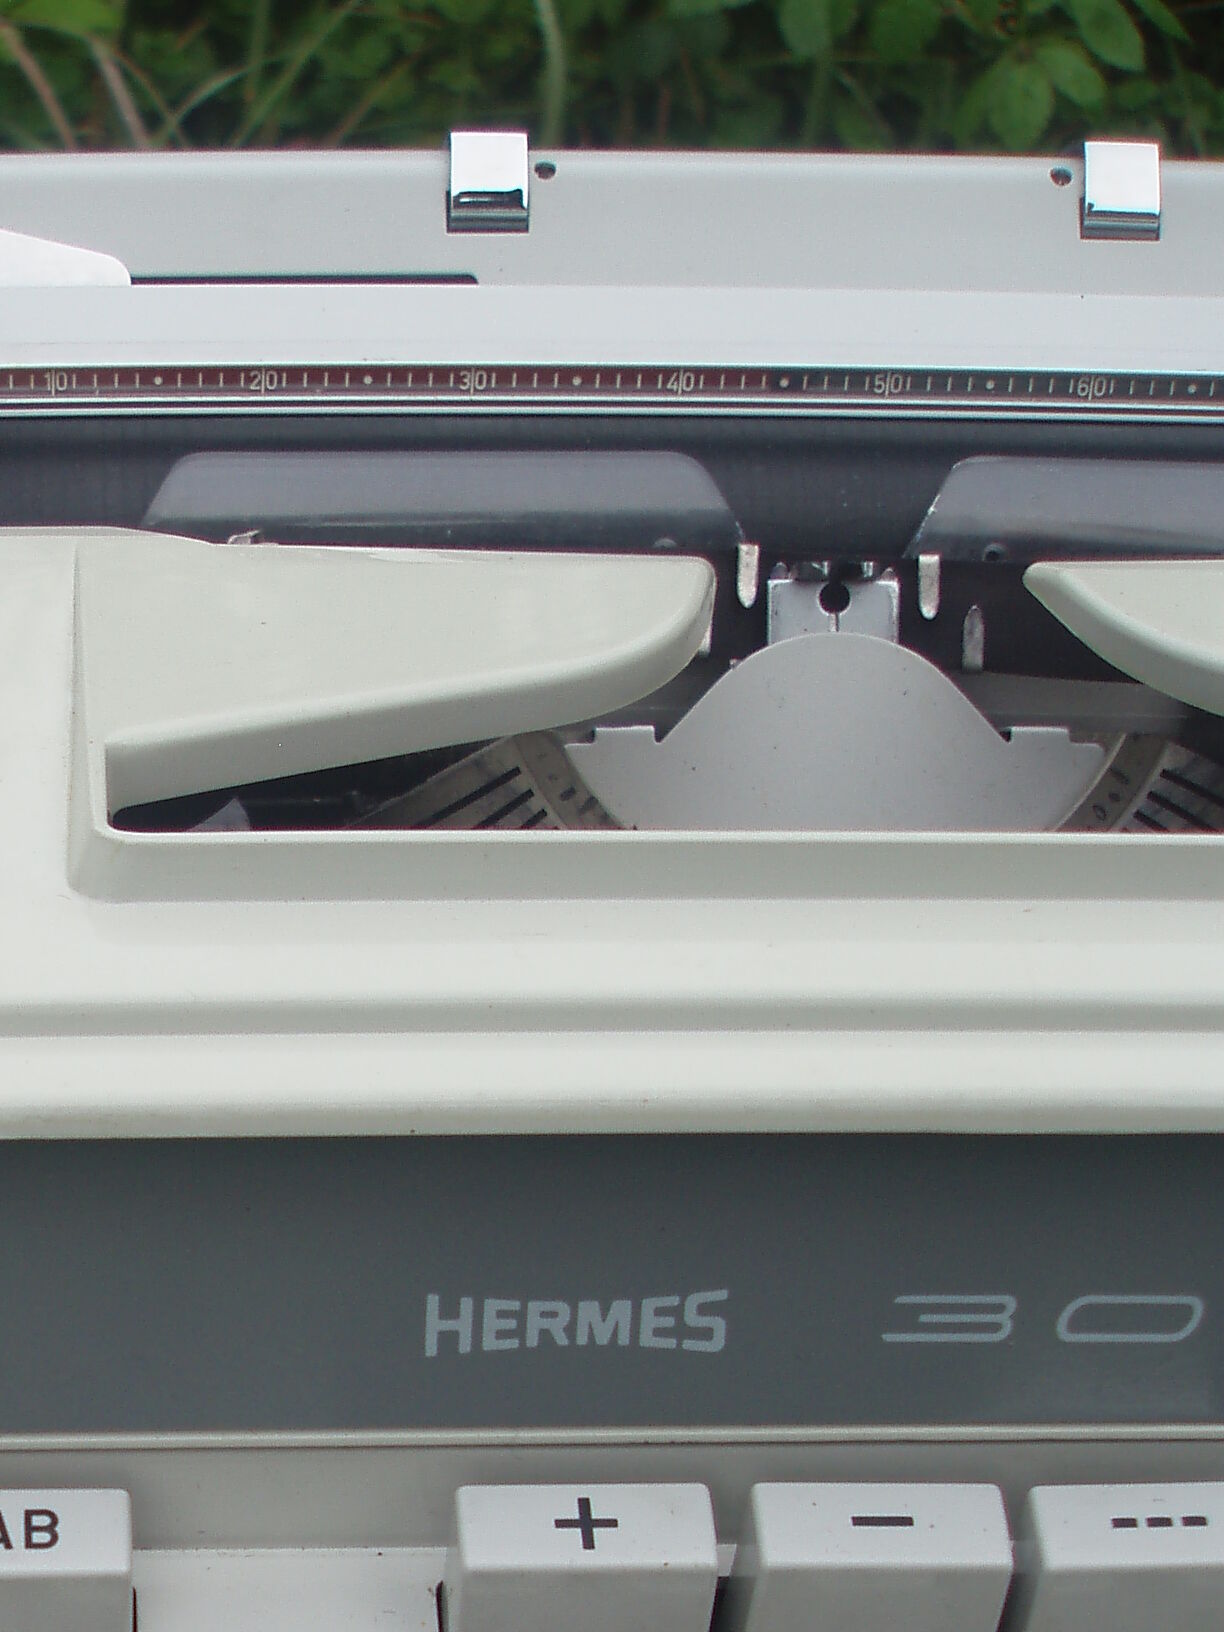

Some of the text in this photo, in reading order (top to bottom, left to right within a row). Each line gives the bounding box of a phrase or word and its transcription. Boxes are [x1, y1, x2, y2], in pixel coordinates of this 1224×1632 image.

[44, 370, 1106, 396] 10 20 30 40 50 60
[424, 1289, 728, 1357] HERMES
